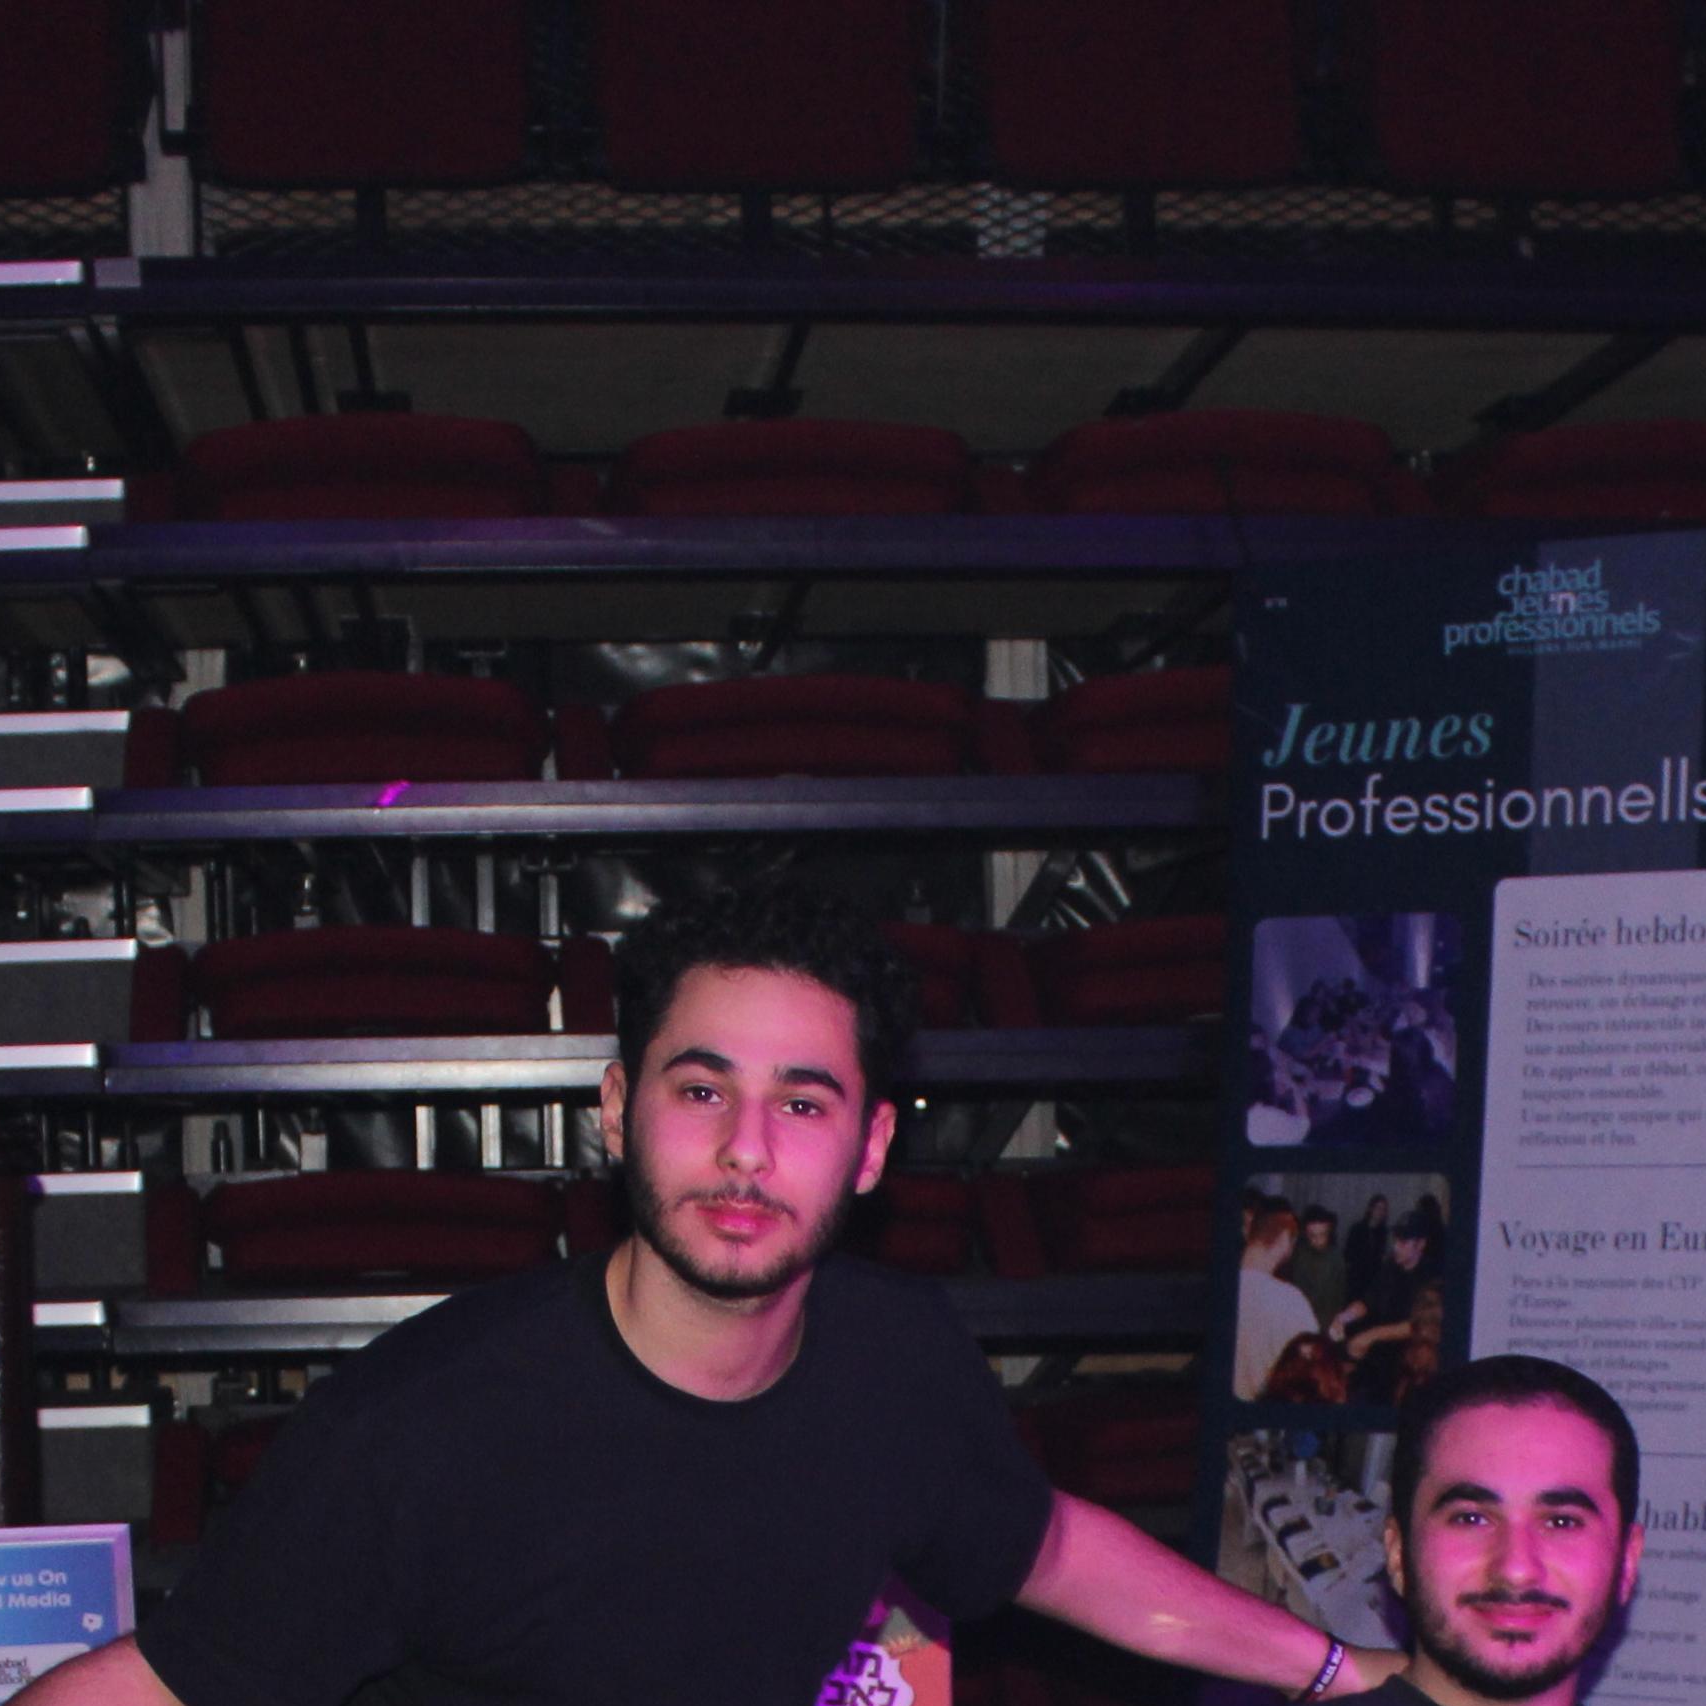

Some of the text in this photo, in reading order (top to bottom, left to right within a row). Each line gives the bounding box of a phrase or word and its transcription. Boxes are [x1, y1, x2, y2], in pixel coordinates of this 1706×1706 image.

[1498, 557, 1602, 597] chabad
[1443, 602, 1662, 656] professionnels
[1262, 703, 1494, 768] Jeunes
[1513, 917, 1607, 951] Soirée
[1497, 1219, 1606, 1259] Voyage
[1613, 1230, 1647, 1251] en
[8, 1590, 71, 1608] Media
[11, 1572, 34, 1589] us
[38, 1569, 67, 1587] On
